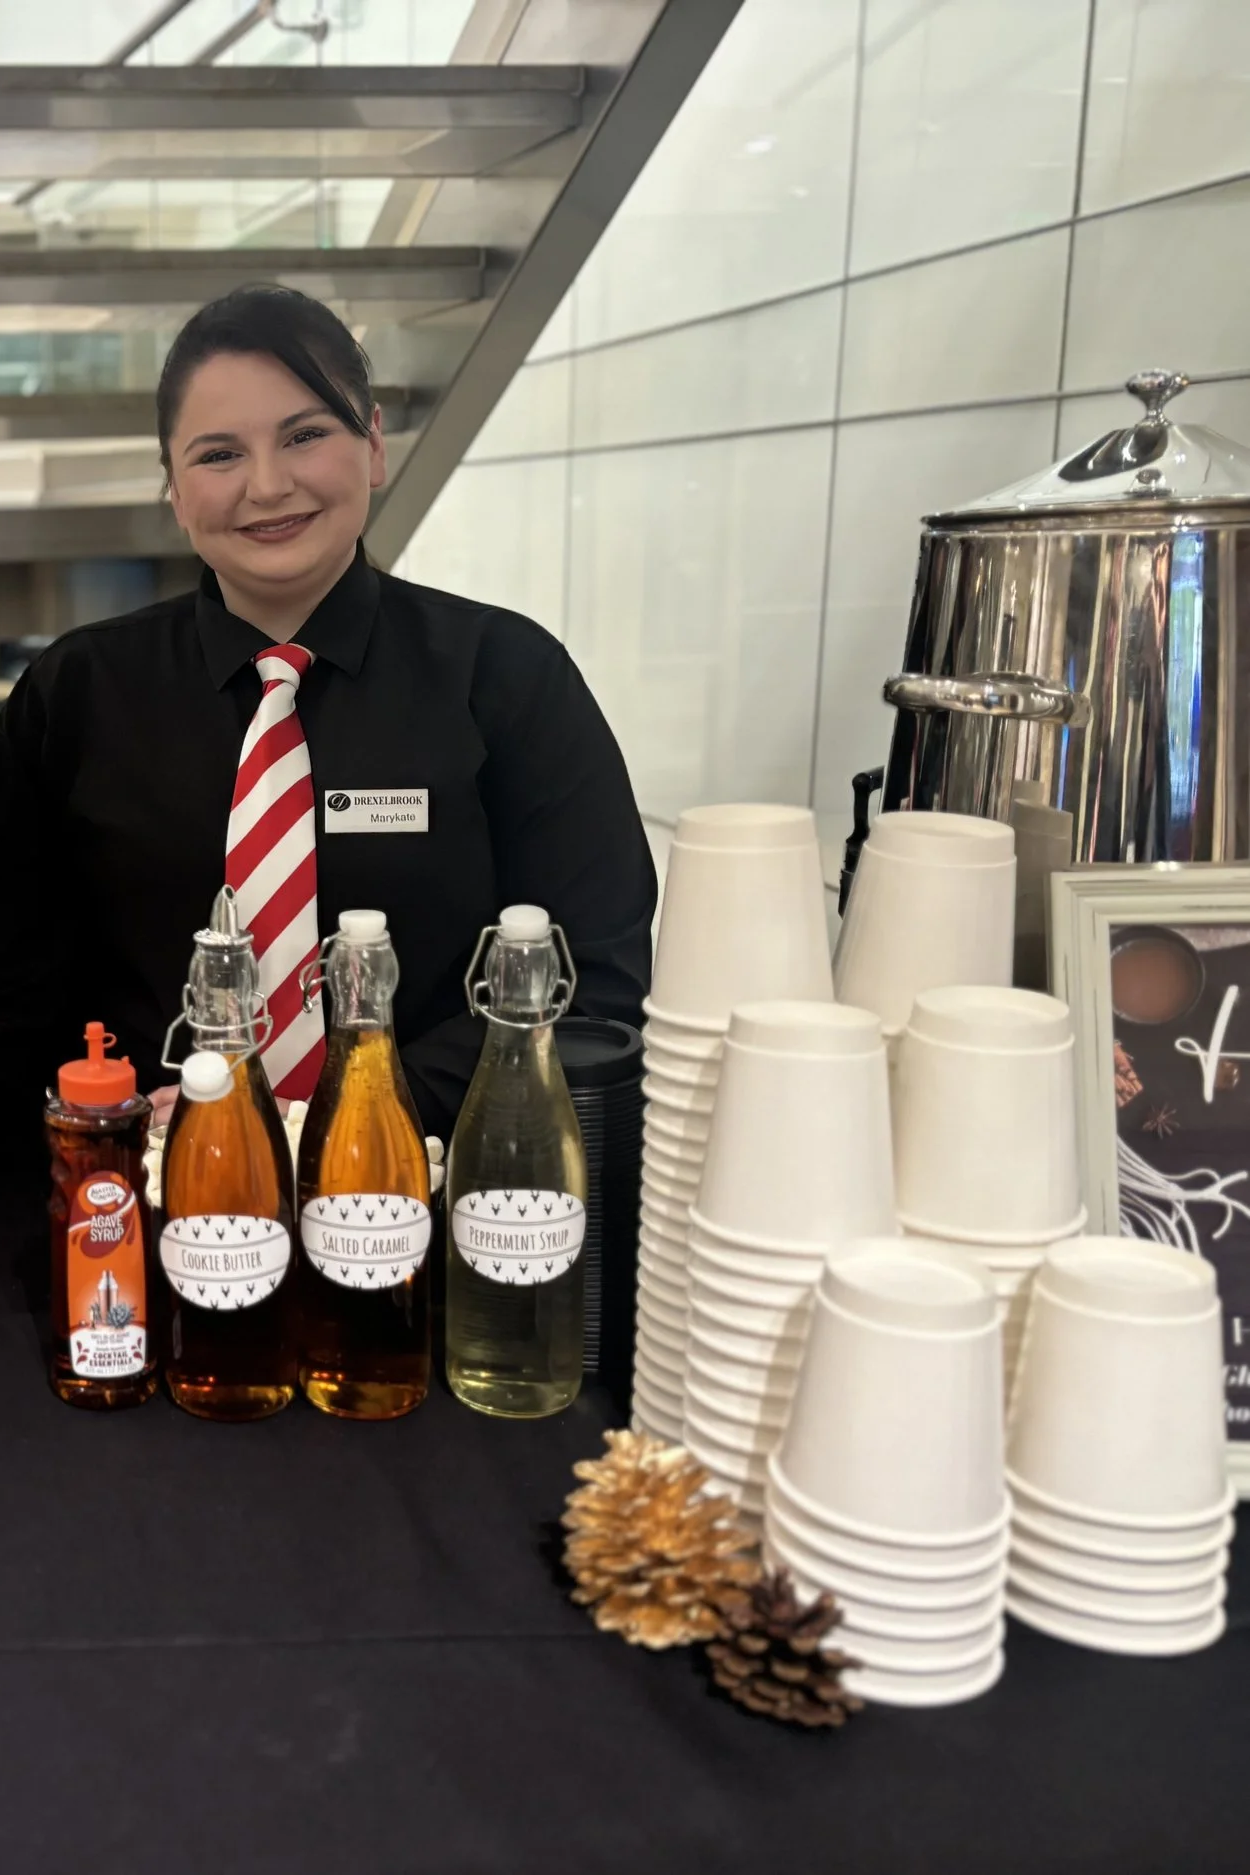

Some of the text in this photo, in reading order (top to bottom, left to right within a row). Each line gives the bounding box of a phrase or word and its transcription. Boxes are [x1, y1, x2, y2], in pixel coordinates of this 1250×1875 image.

[354, 795, 423, 806] DREXELBROOK
[370, 812, 416, 823] Marykate
[90, 1212, 124, 1229] AGAVE
[90, 1227, 125, 1242] SYRUP
[469, 1225, 569, 1251] PEPPERMINT SYRUP
[321, 1231, 411, 1256] SALTED CARAMEL
[181, 1248, 263, 1272] COOKIE BUTTER
[89, 1356, 133, 1367] ESSENTIALS
[93, 1350, 128, 1360] COCKTAIL
